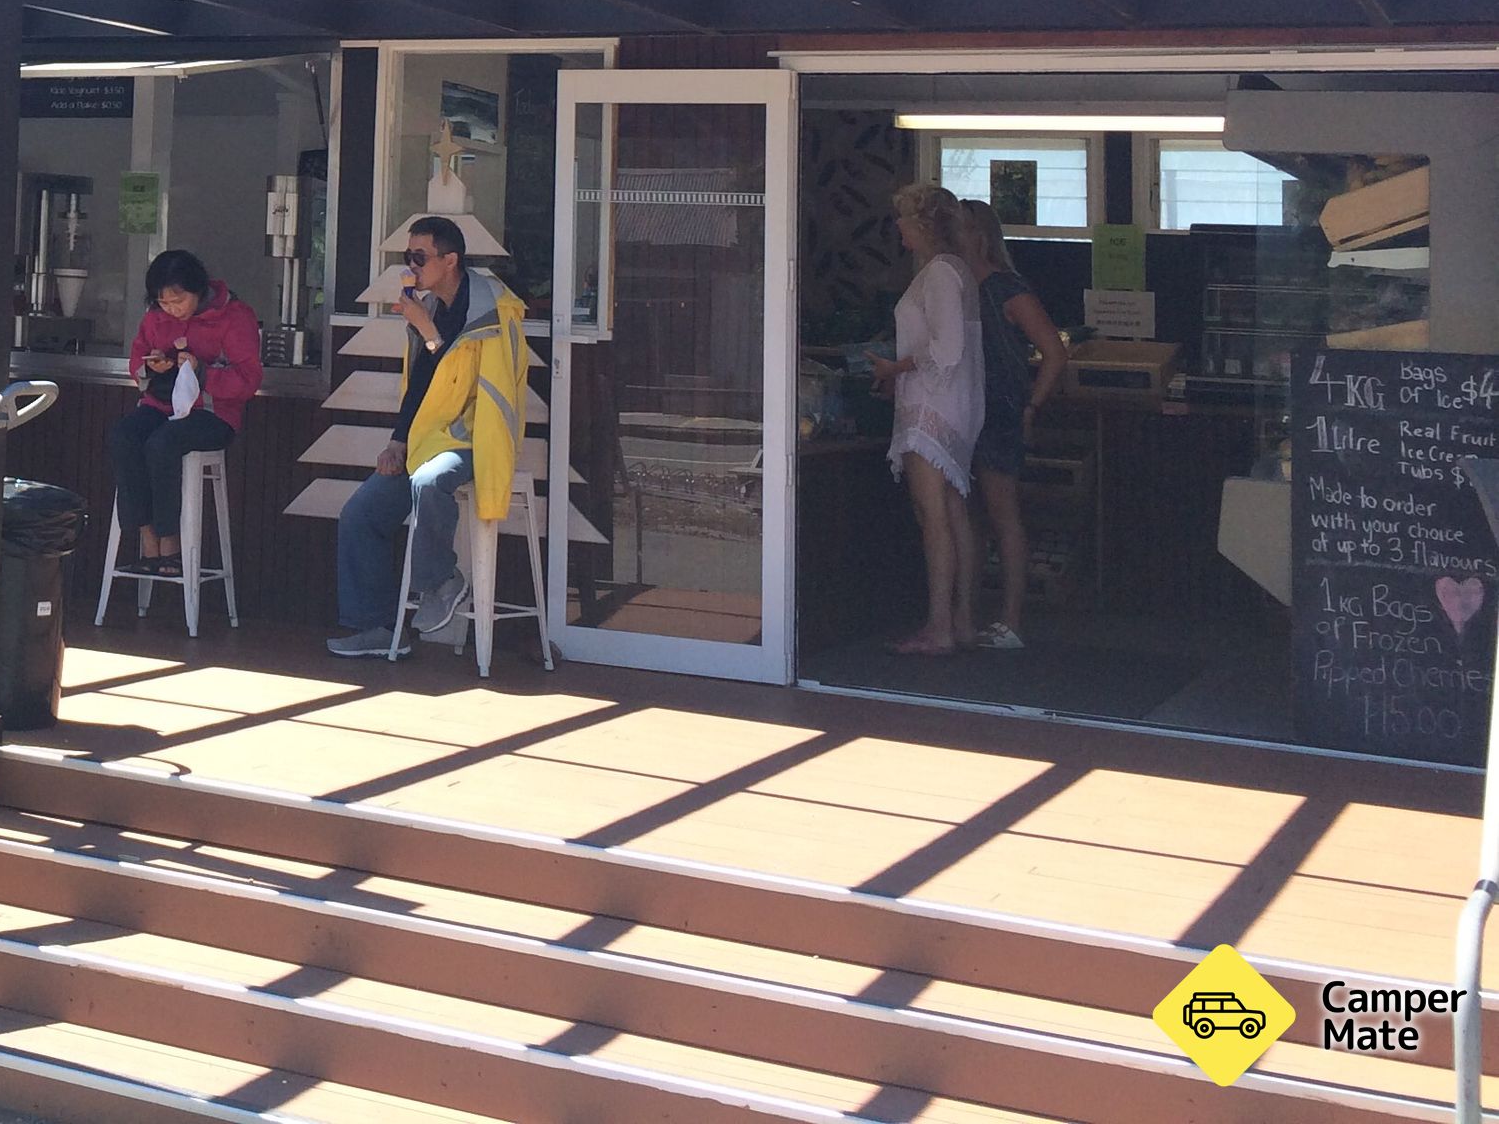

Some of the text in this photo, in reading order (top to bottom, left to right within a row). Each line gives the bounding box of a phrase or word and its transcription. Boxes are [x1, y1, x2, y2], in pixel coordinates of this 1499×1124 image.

[1400, 361, 1447, 390] Bags
[1436, 388, 1463, 410] Ice
[1400, 420, 1497, 447] Real Fruit
[1400, 440, 1424, 461] Ice
[1398, 461, 1445, 481] Tubs
[1309, 476, 1437, 516] Made to order
[1311, 511, 1466, 544] with your choice
[1337, 540, 1357, 563] up
[1360, 538, 1381, 556] to
[1387, 537, 1404, 562] 3
[1411, 540, 1497, 577] flavours
[1372, 583, 1434, 635] Bags
[1316, 616, 1443, 654] of Frozen
